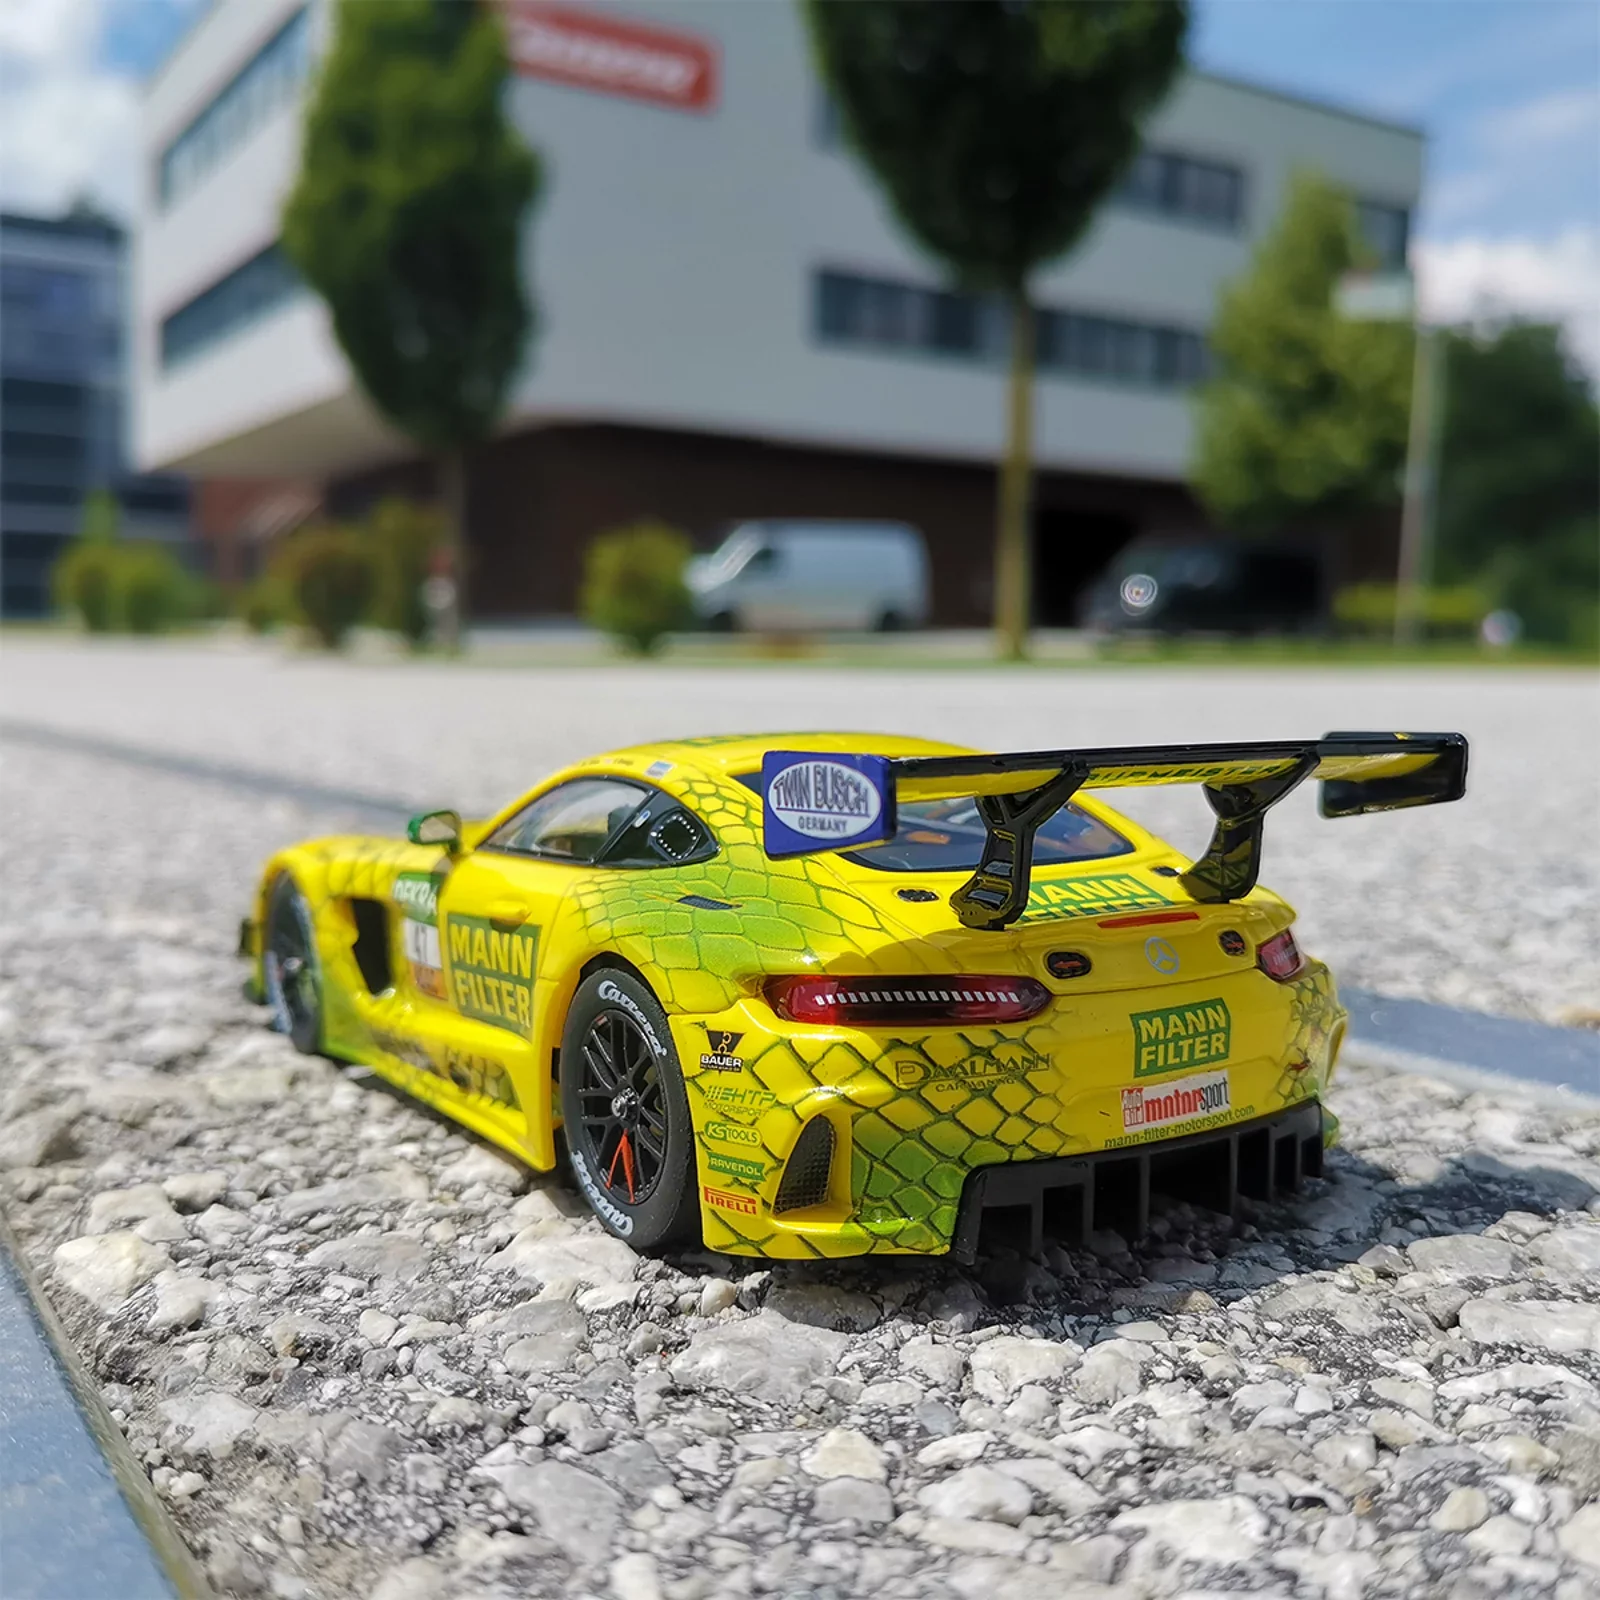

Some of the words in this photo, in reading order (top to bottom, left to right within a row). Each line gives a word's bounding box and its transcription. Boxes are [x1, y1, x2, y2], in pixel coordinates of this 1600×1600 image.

[774, 763, 810, 809] TWIN
[812, 764, 869, 816] BUSCH
[798, 816, 848, 833] GERMANY
[450, 923, 534, 979] MANN
[454, 969, 531, 1028] FILTER
[598, 980, 668, 1058] Carrera
[1138, 1005, 1227, 1043] MANN
[701, 1054, 742, 1068] BAUER
[1140, 1032, 1226, 1070] FILTER
[1104, 1104, 1255, 1148] mann-filter-motorsport.com
[710, 1157, 761, 1177] RAVENOL
[571, 1149, 634, 1236] Carrera
[704, 1186, 757, 1215] PIRELLI
